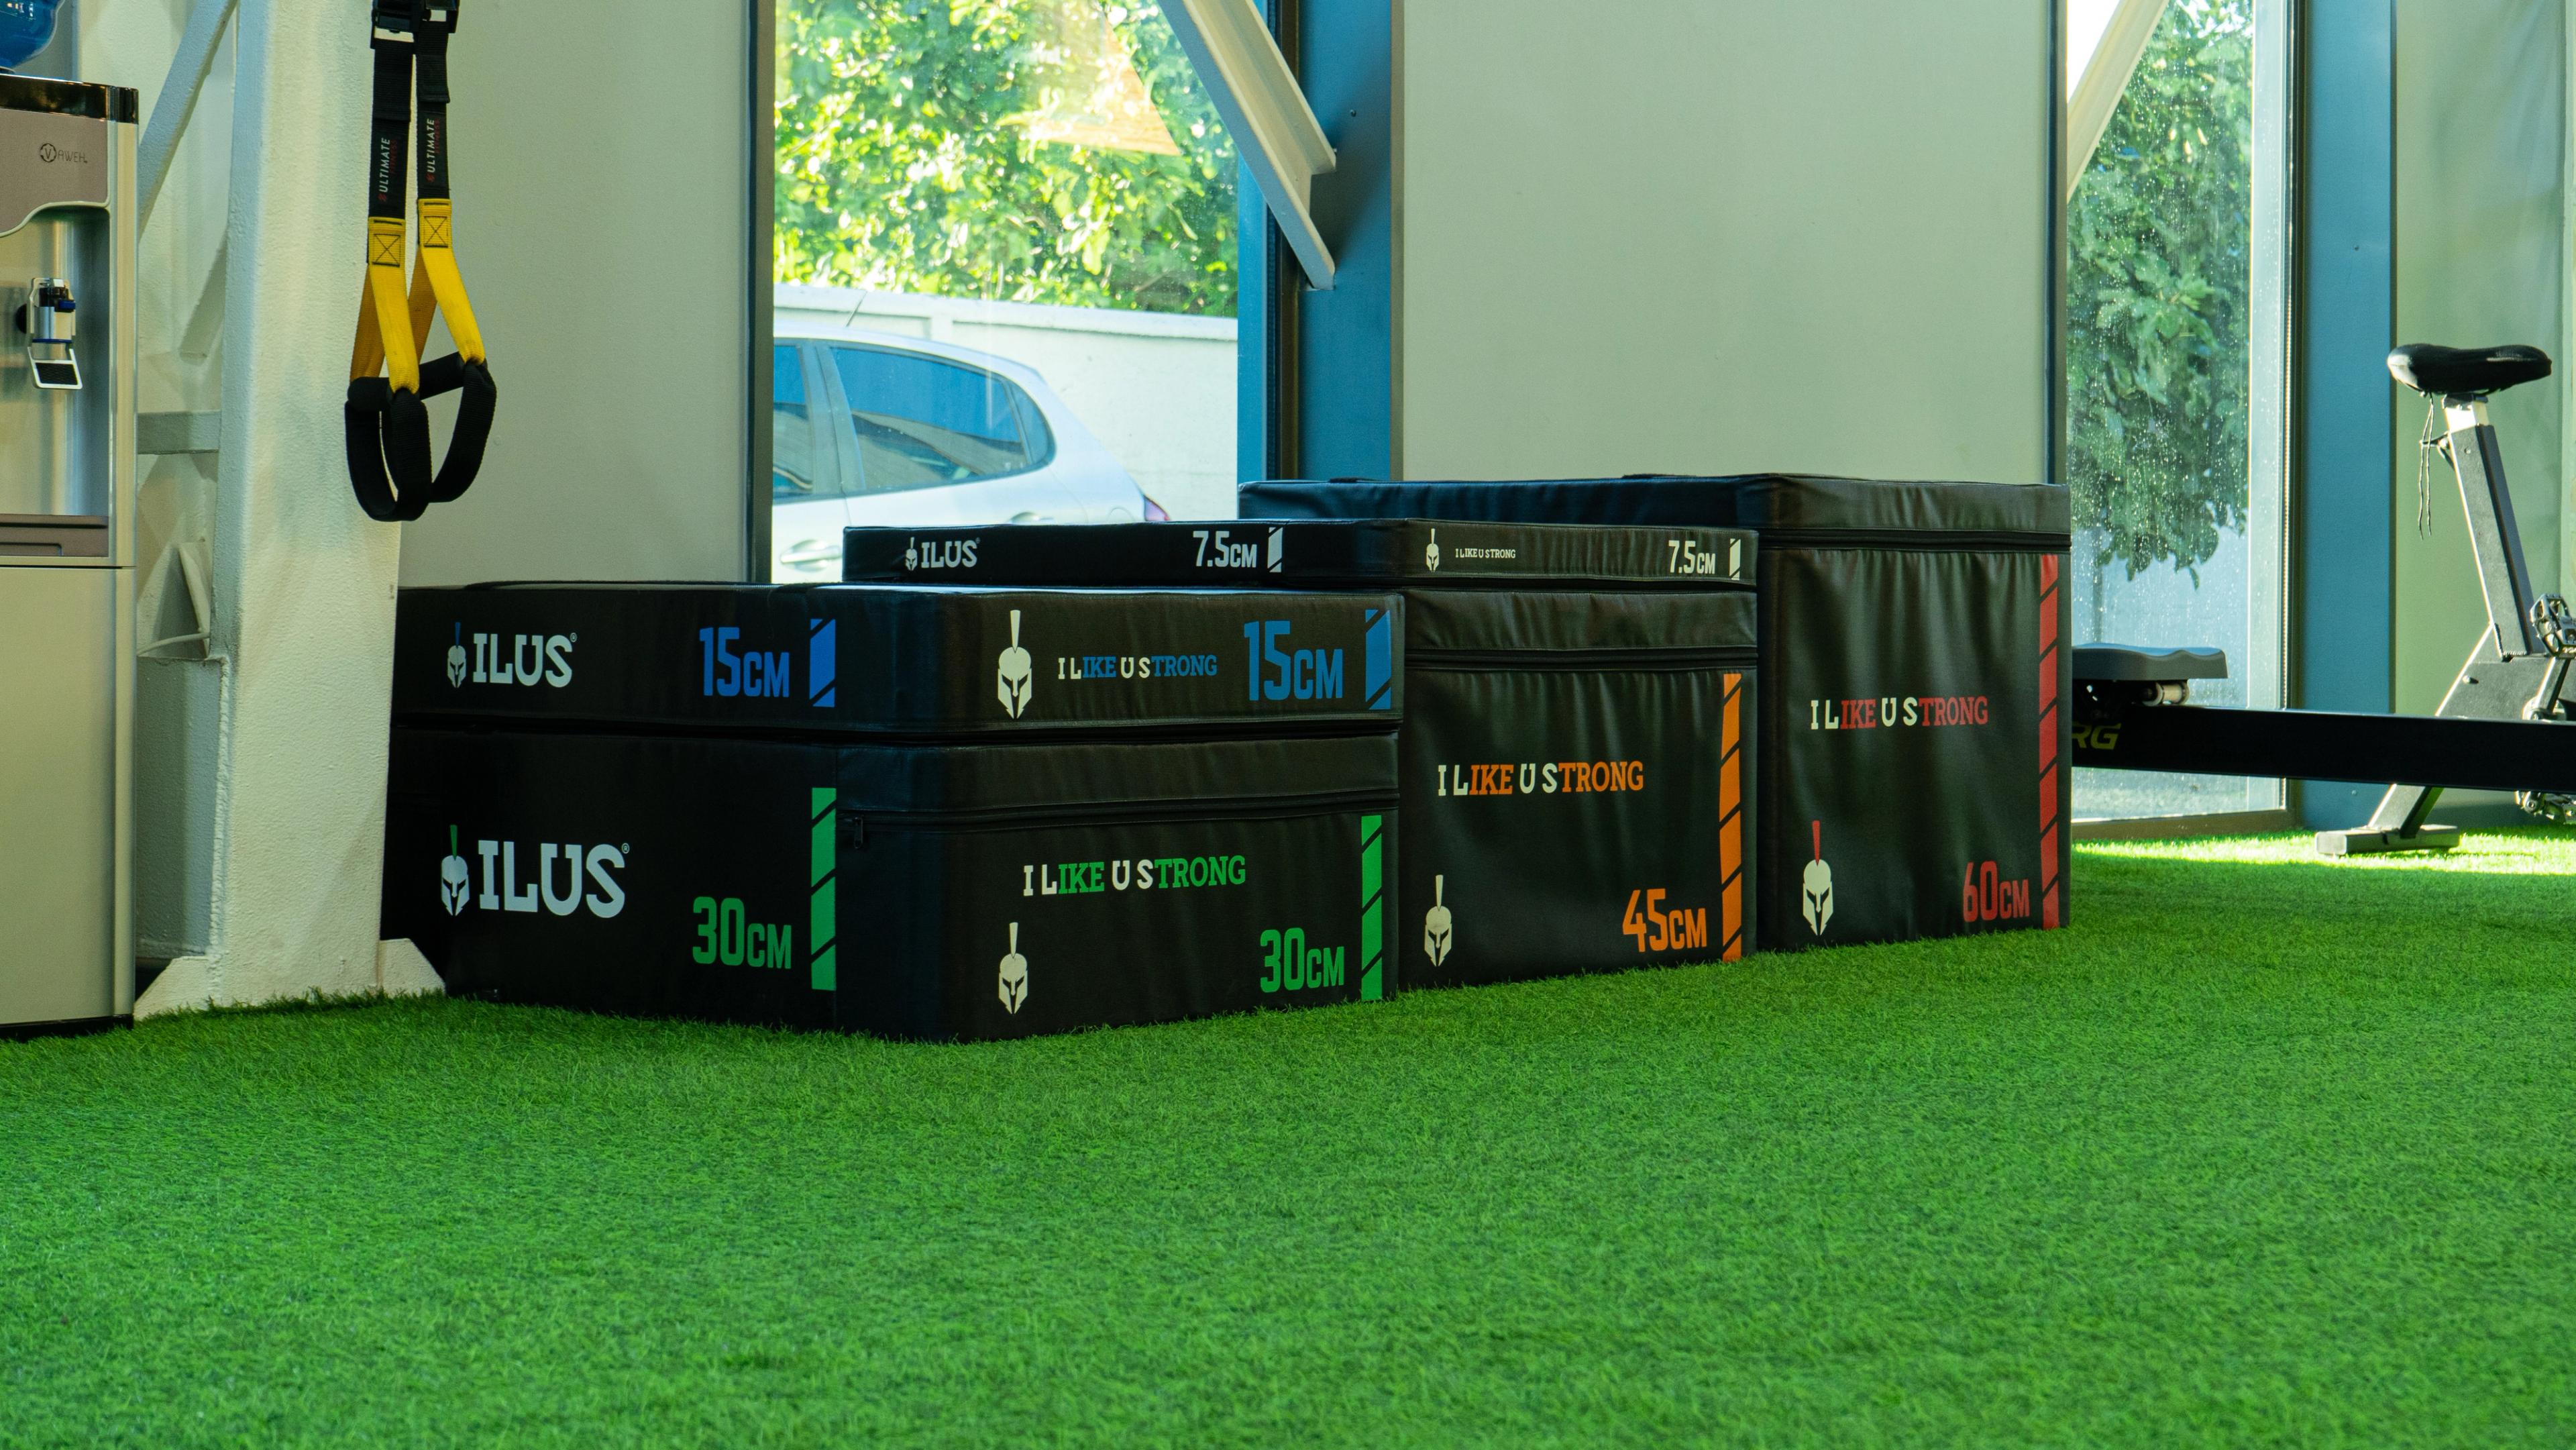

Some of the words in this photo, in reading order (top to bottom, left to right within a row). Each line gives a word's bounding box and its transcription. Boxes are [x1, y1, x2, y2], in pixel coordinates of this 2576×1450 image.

[378, 137, 390, 193] ULTIMATE
[426, 118, 435, 173] ULTIMATE
[1193, 530, 1258, 568] 7.5CM
[1454, 548, 1459, 558] I
[1460, 548, 1478, 558] LIKE
[1478, 549, 1484, 559] U
[1485, 549, 1516, 559] STRONG
[1668, 539, 1716, 574] 7.5CM
[699, 626, 790, 698] 15CM
[1058, 657, 1066, 680] I
[1070, 656, 1117, 680] LIKE
[1120, 657, 1134, 679] U
[1138, 654, 1218, 679] STRONG
[1244, 620, 1343, 701] 15CM
[1810, 699, 1819, 730] I
[1824, 698, 1876, 729] LIKE
[1881, 697, 1897, 727] U
[1902, 695, 1989, 727] STRONG
[1437, 764, 1448, 797] I
[1453, 764, 1514, 796] LIKE
[1519, 763, 1536, 794] U
[1542, 760, 1644, 794] STRONG
[1023, 865, 1034, 897] I
[1041, 861, 1106, 896] LIKE
[1112, 860, 1130, 891] U
[1136, 854, 1246, 890] STRONG
[1962, 860, 2030, 923] 60CM
[692, 896, 792, 970] 30CM
[1622, 888, 1708, 953] 45CM
[1260, 927, 1345, 994] 30CM
